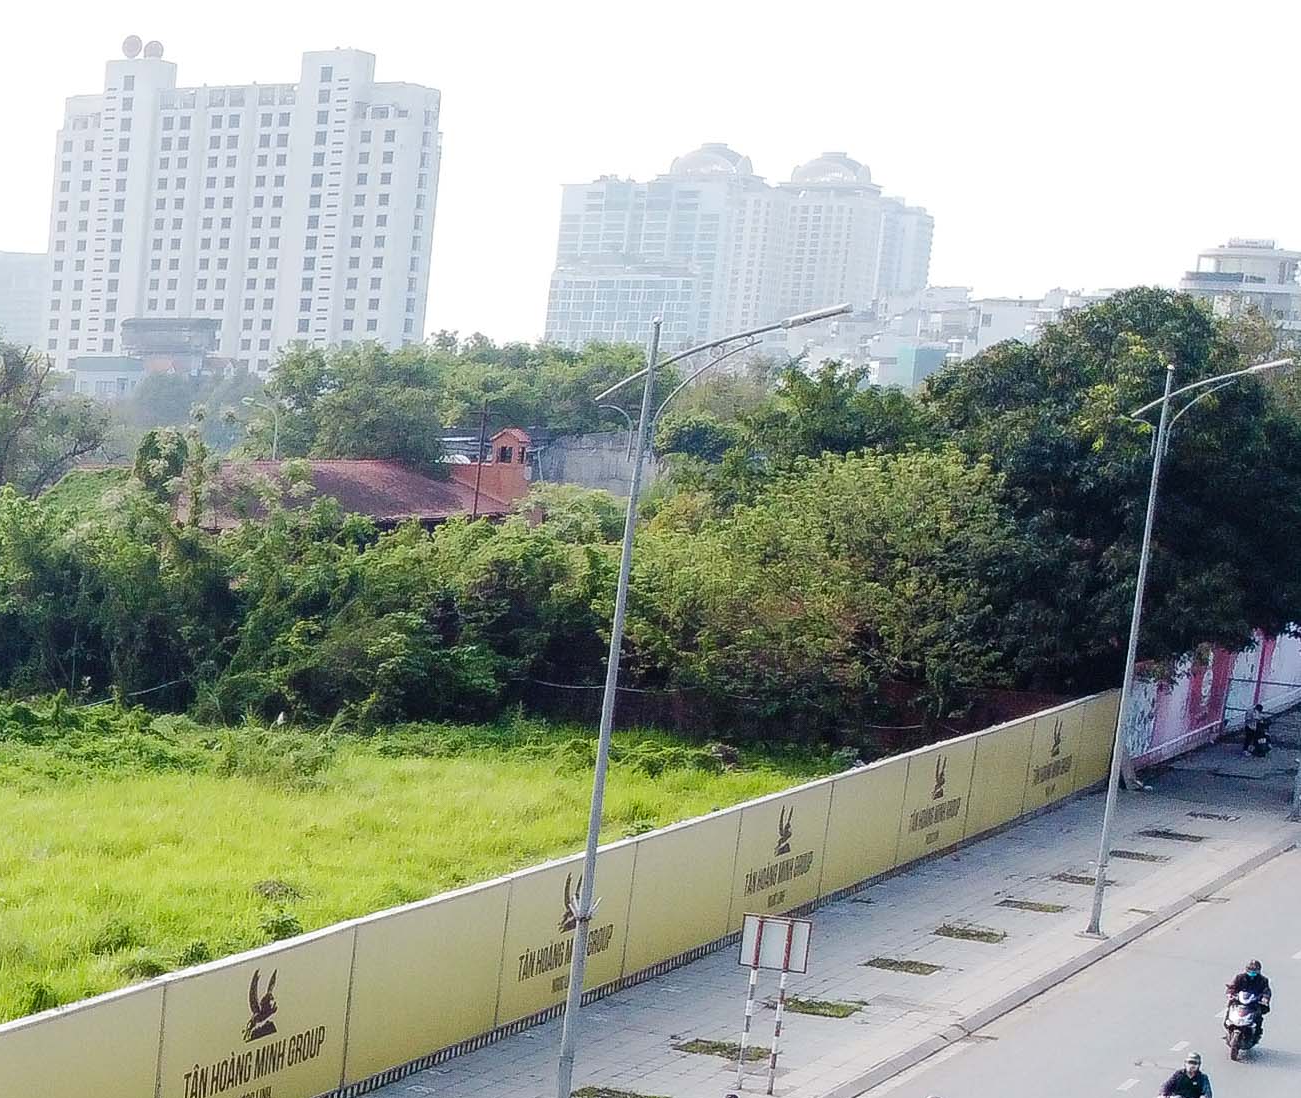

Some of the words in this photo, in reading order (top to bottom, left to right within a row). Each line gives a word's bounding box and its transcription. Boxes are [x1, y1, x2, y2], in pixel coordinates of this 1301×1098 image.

[210, 1051, 252, 1097] HOÀNG
[253, 1038, 286, 1081] MINH
[287, 1025, 326, 1067] GROUP
